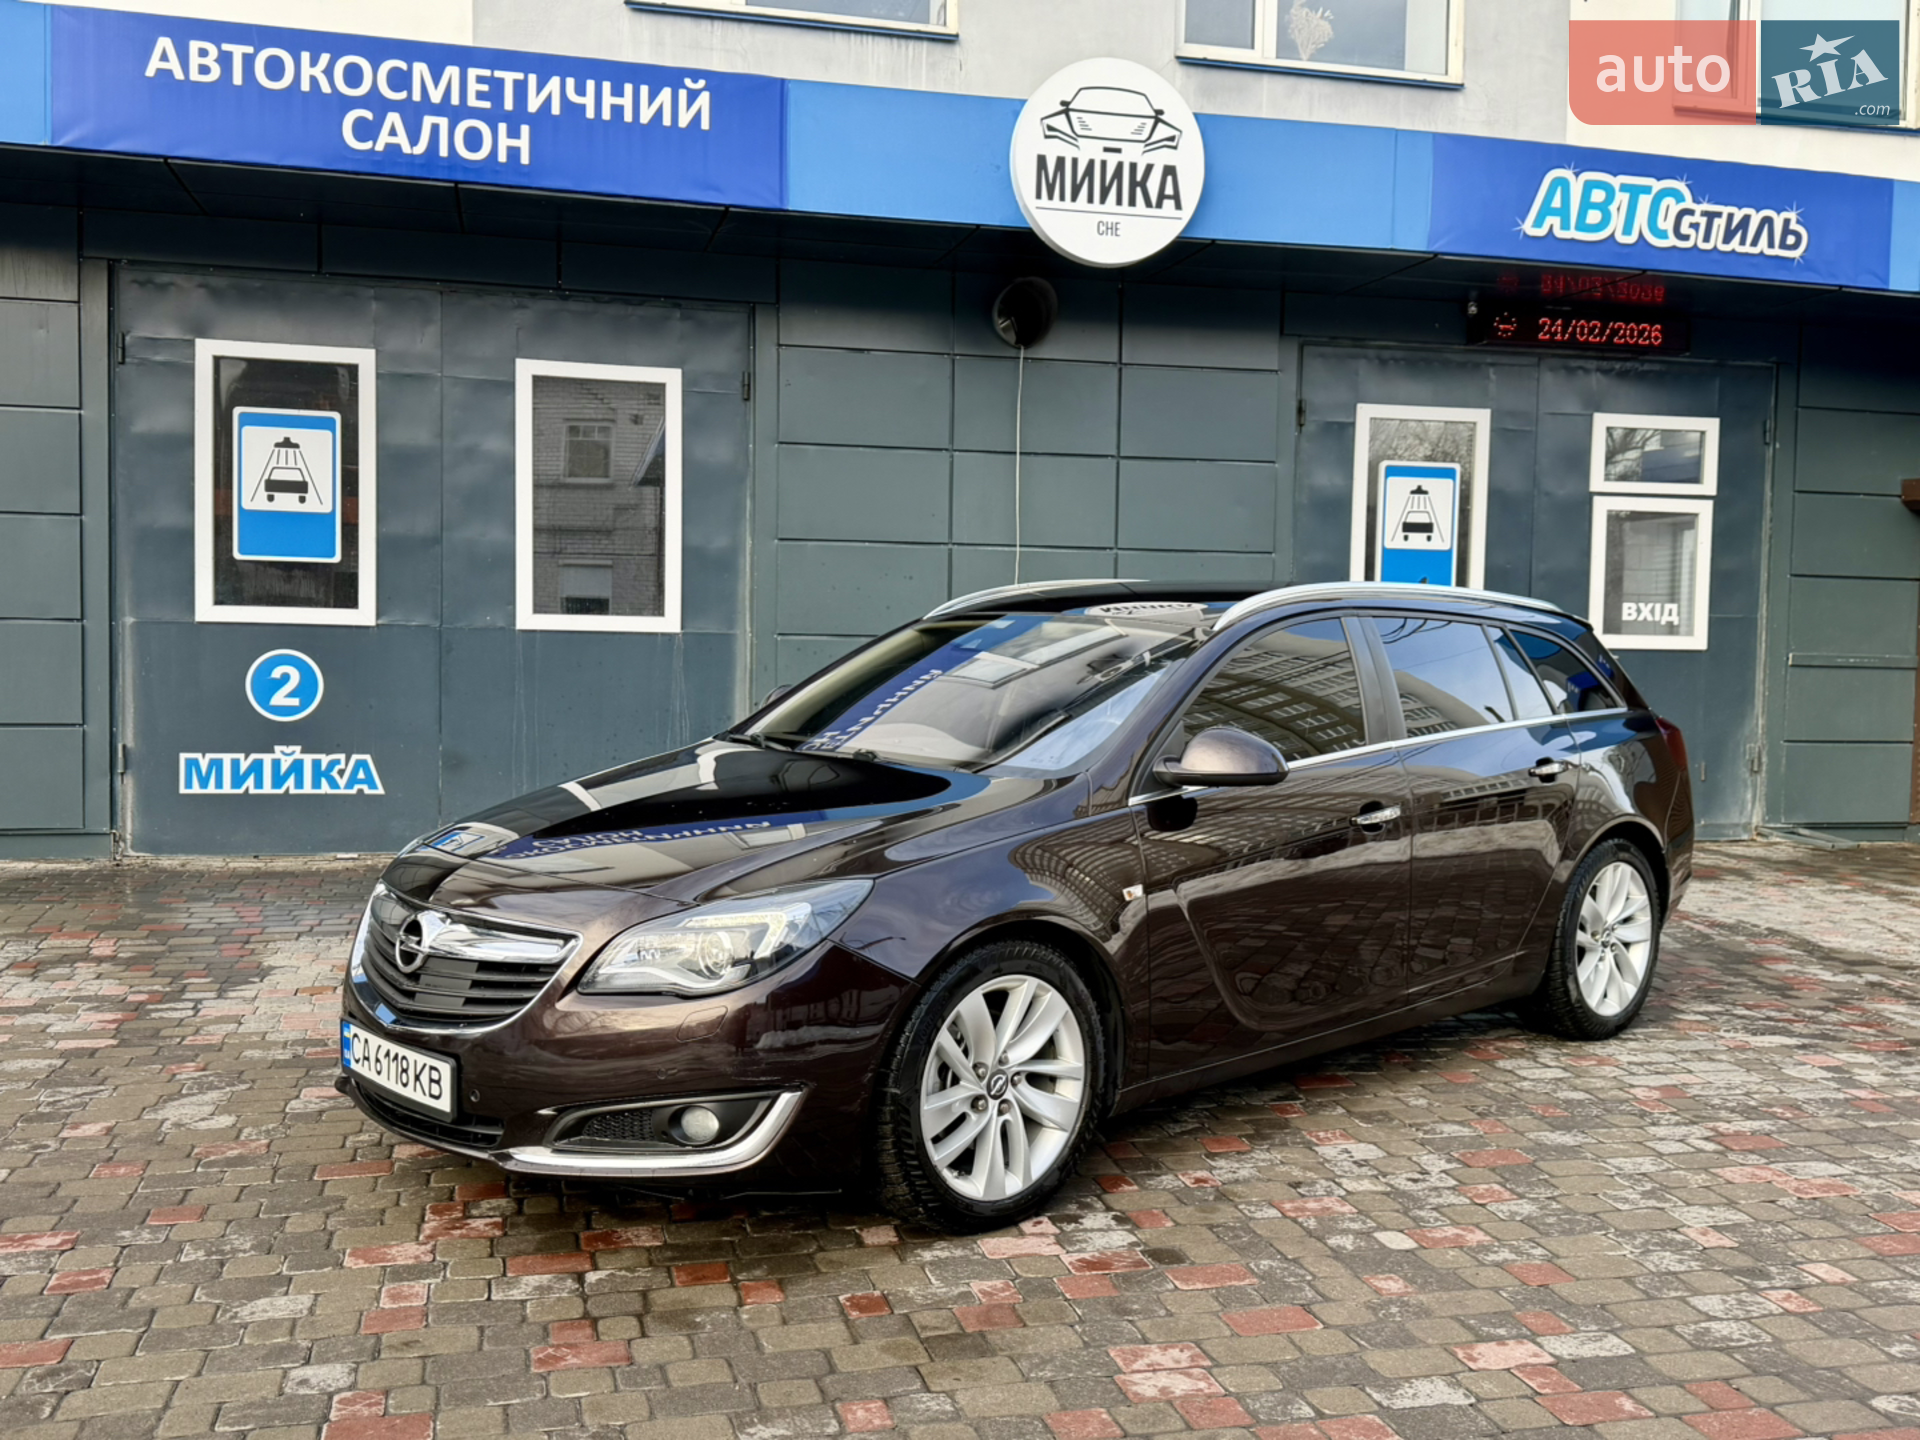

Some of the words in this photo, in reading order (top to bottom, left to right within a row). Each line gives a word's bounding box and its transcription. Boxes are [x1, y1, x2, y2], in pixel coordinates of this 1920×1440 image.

[145, 36, 711, 130] АВТОКОСМЕТИЧНИЙ
[341, 109, 531, 165] САЛОН
[1035, 147, 1183, 211] МИЙКА
[1621, 602, 1680, 626] ВХІД
[267, 664, 301, 707] 2
[180, 746, 384, 793] МИЙКА
